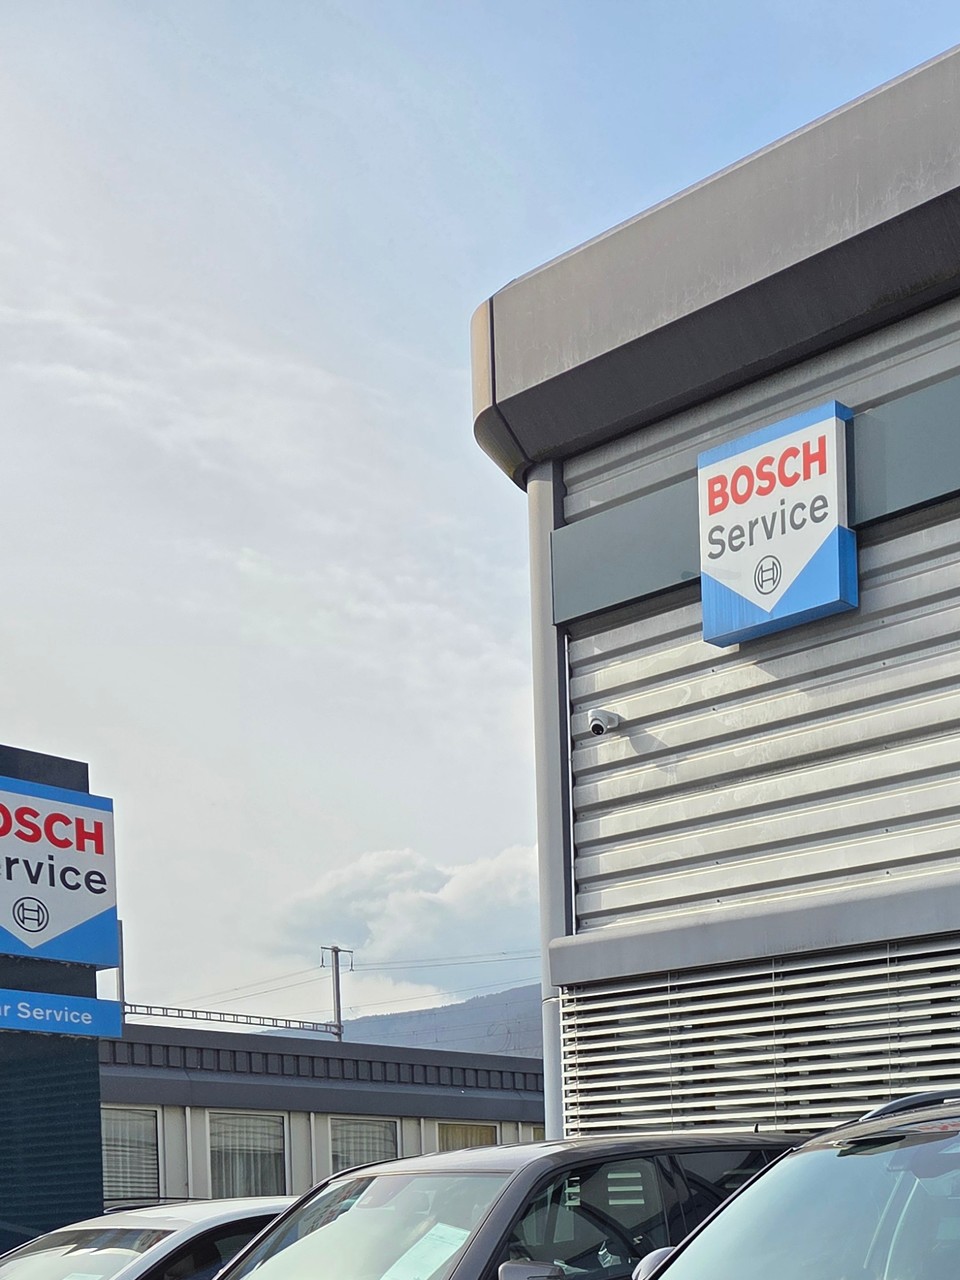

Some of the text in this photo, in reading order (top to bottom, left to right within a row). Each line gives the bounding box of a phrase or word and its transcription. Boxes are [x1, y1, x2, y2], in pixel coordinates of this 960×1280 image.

[707, 434, 827, 516] BOSCH
[707, 494, 829, 560] Service
[0, 854, 107, 894] rvice
[17, 1002, 92, 1024] Service
